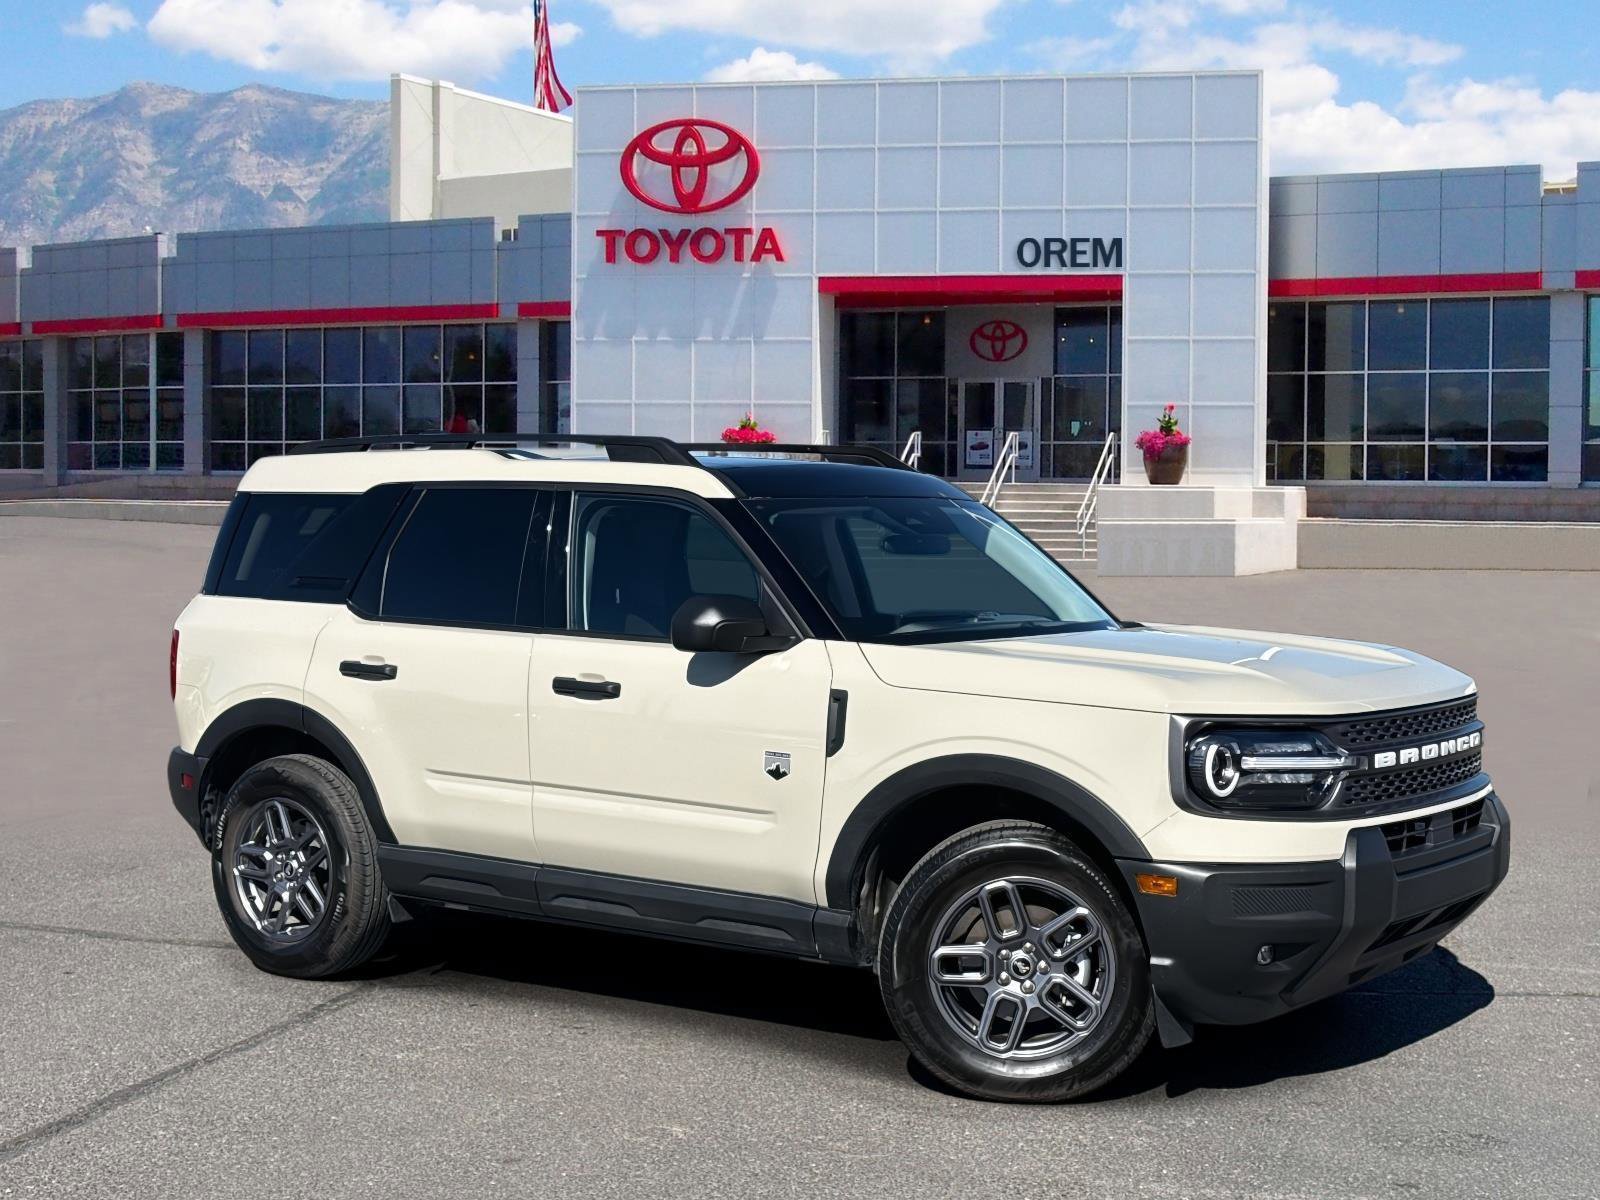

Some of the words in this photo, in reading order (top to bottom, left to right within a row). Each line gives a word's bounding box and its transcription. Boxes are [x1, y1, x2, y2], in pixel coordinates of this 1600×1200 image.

[596, 227, 784, 264] TOYOTA
[1017, 237, 1122, 267] OREM
[1374, 732, 1480, 768] BRONCO
